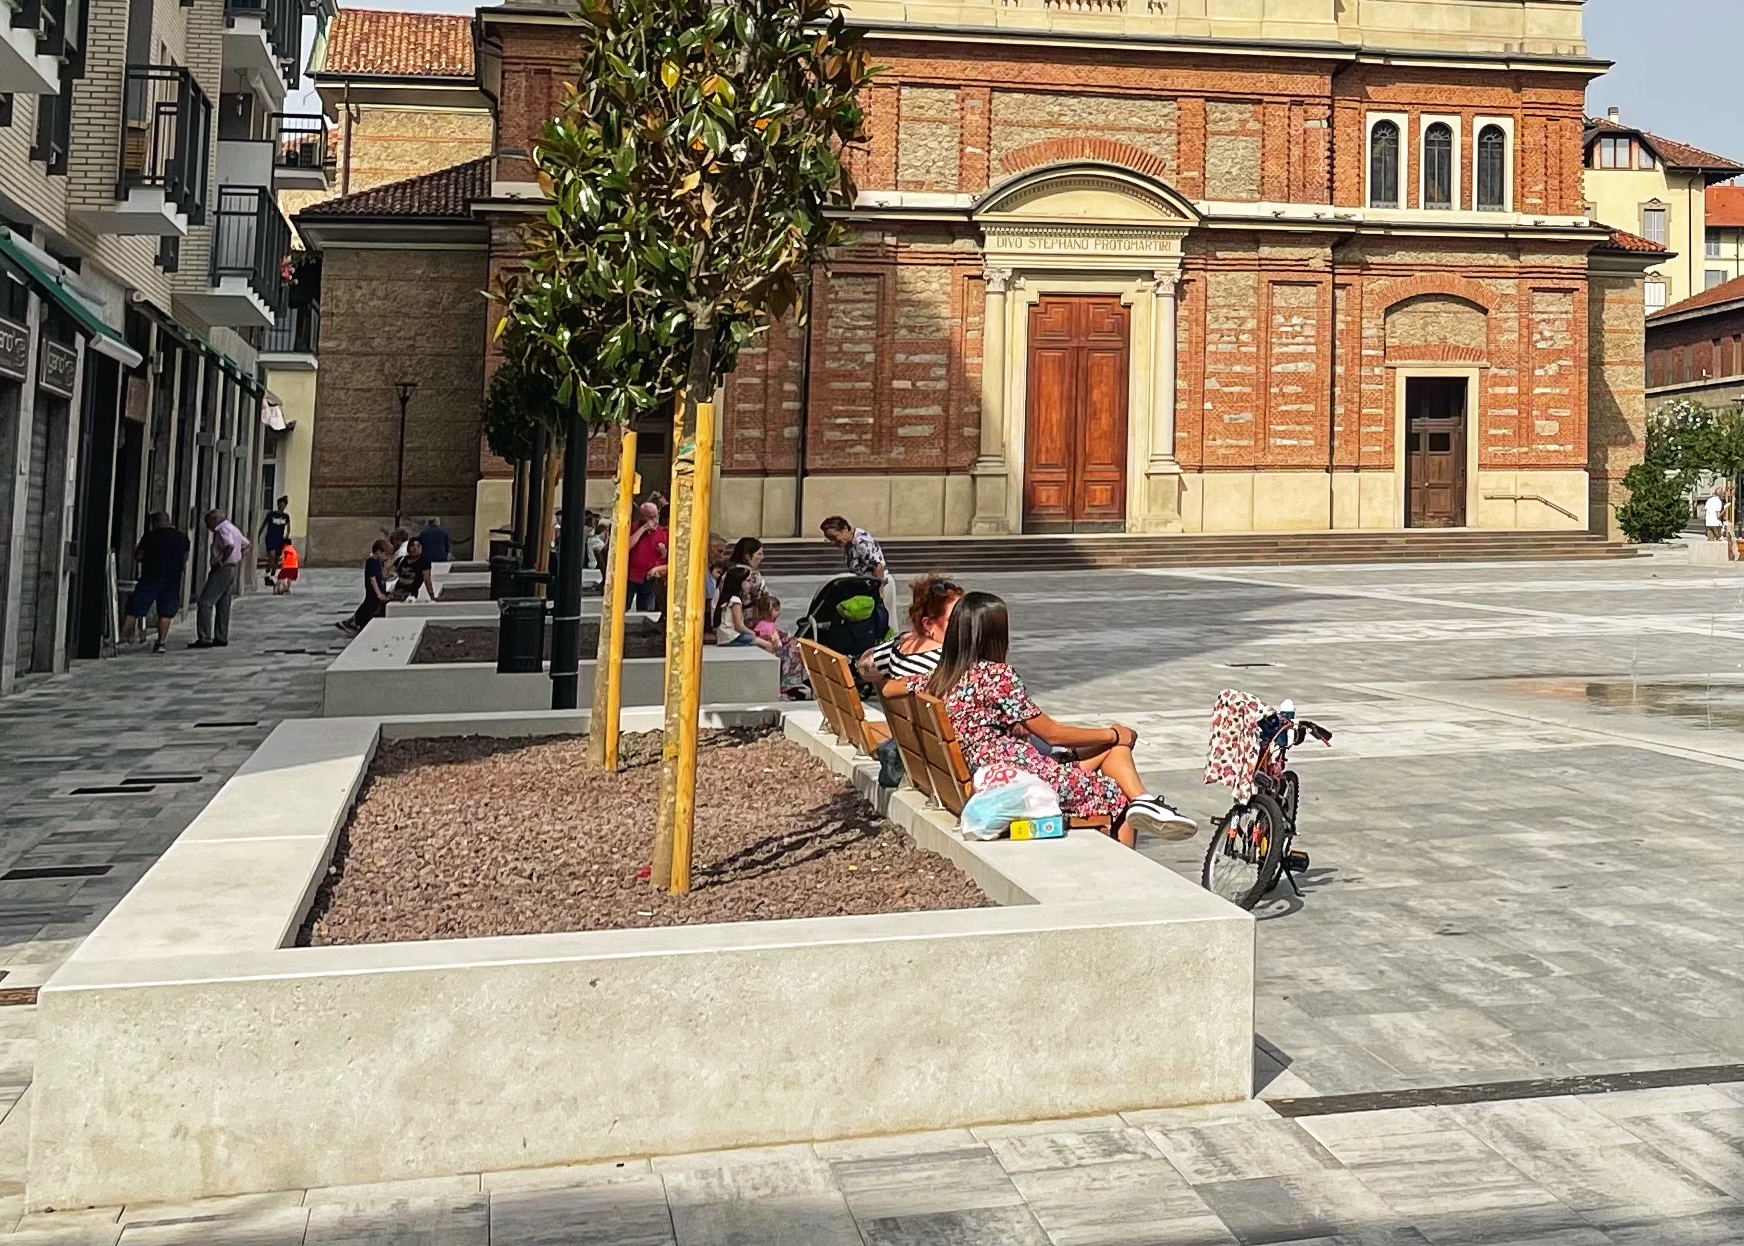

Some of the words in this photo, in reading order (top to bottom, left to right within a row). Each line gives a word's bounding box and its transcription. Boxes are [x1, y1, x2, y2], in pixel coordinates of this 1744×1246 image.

[996, 236, 1023, 249] DIVO
[1028, 237, 1089, 251] STEPHANO
[1094, 239, 1171, 252] PROTOMARTIRI
